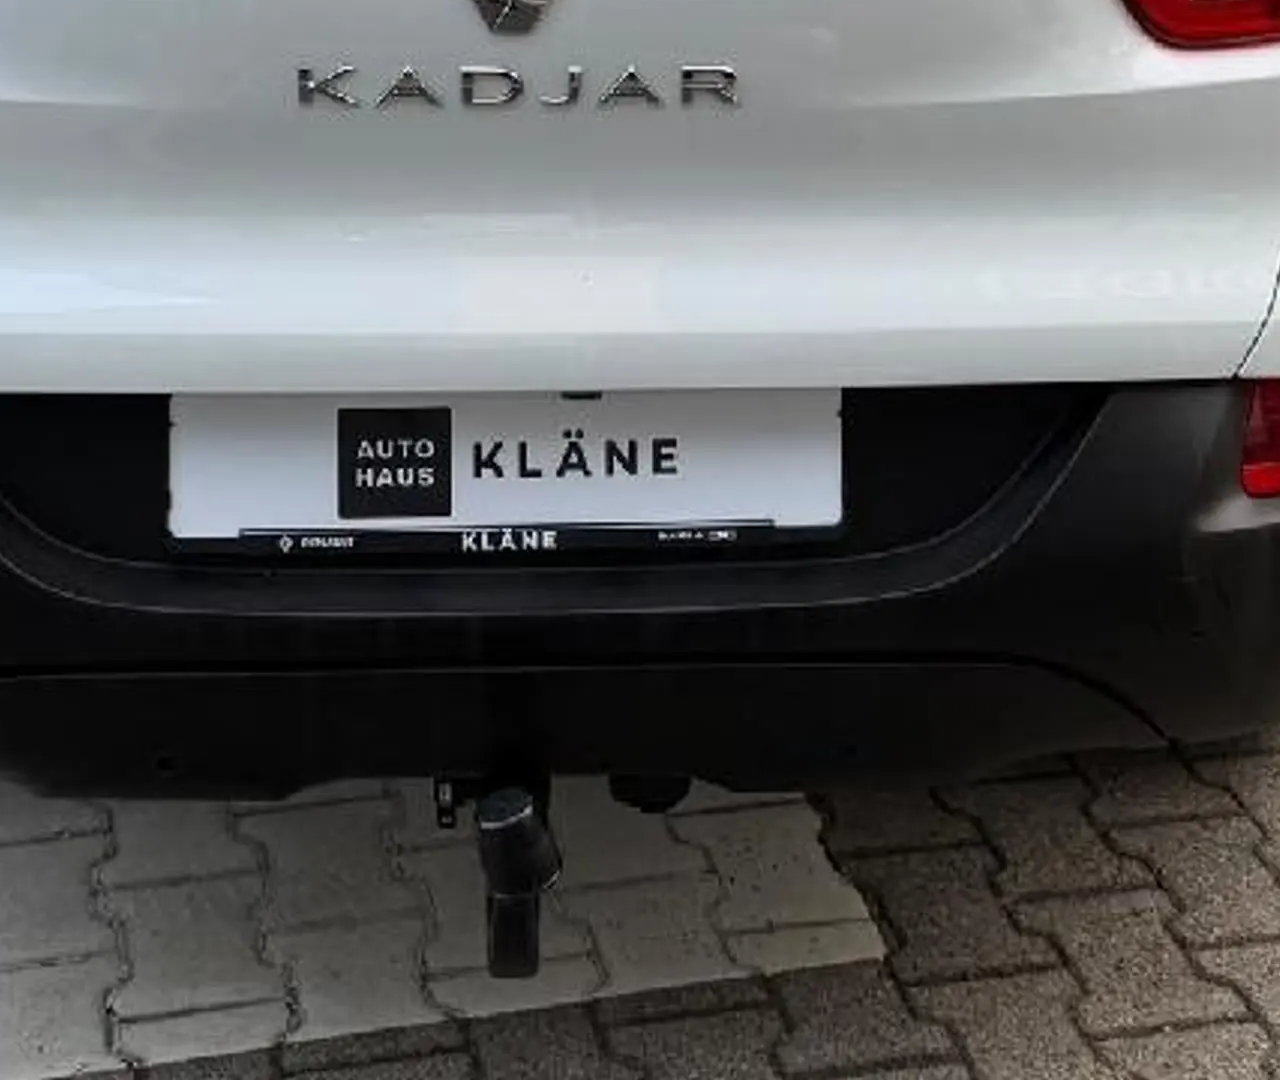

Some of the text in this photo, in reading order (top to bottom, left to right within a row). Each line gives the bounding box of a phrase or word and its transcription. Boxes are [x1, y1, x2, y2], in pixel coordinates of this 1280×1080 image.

[296, 64, 741, 107] KADJAR
[356, 438, 435, 459] AUTO
[472, 428, 679, 479] KLÄNE
[355, 467, 435, 488] HAUS
[461, 528, 558, 552] KLÄNE
